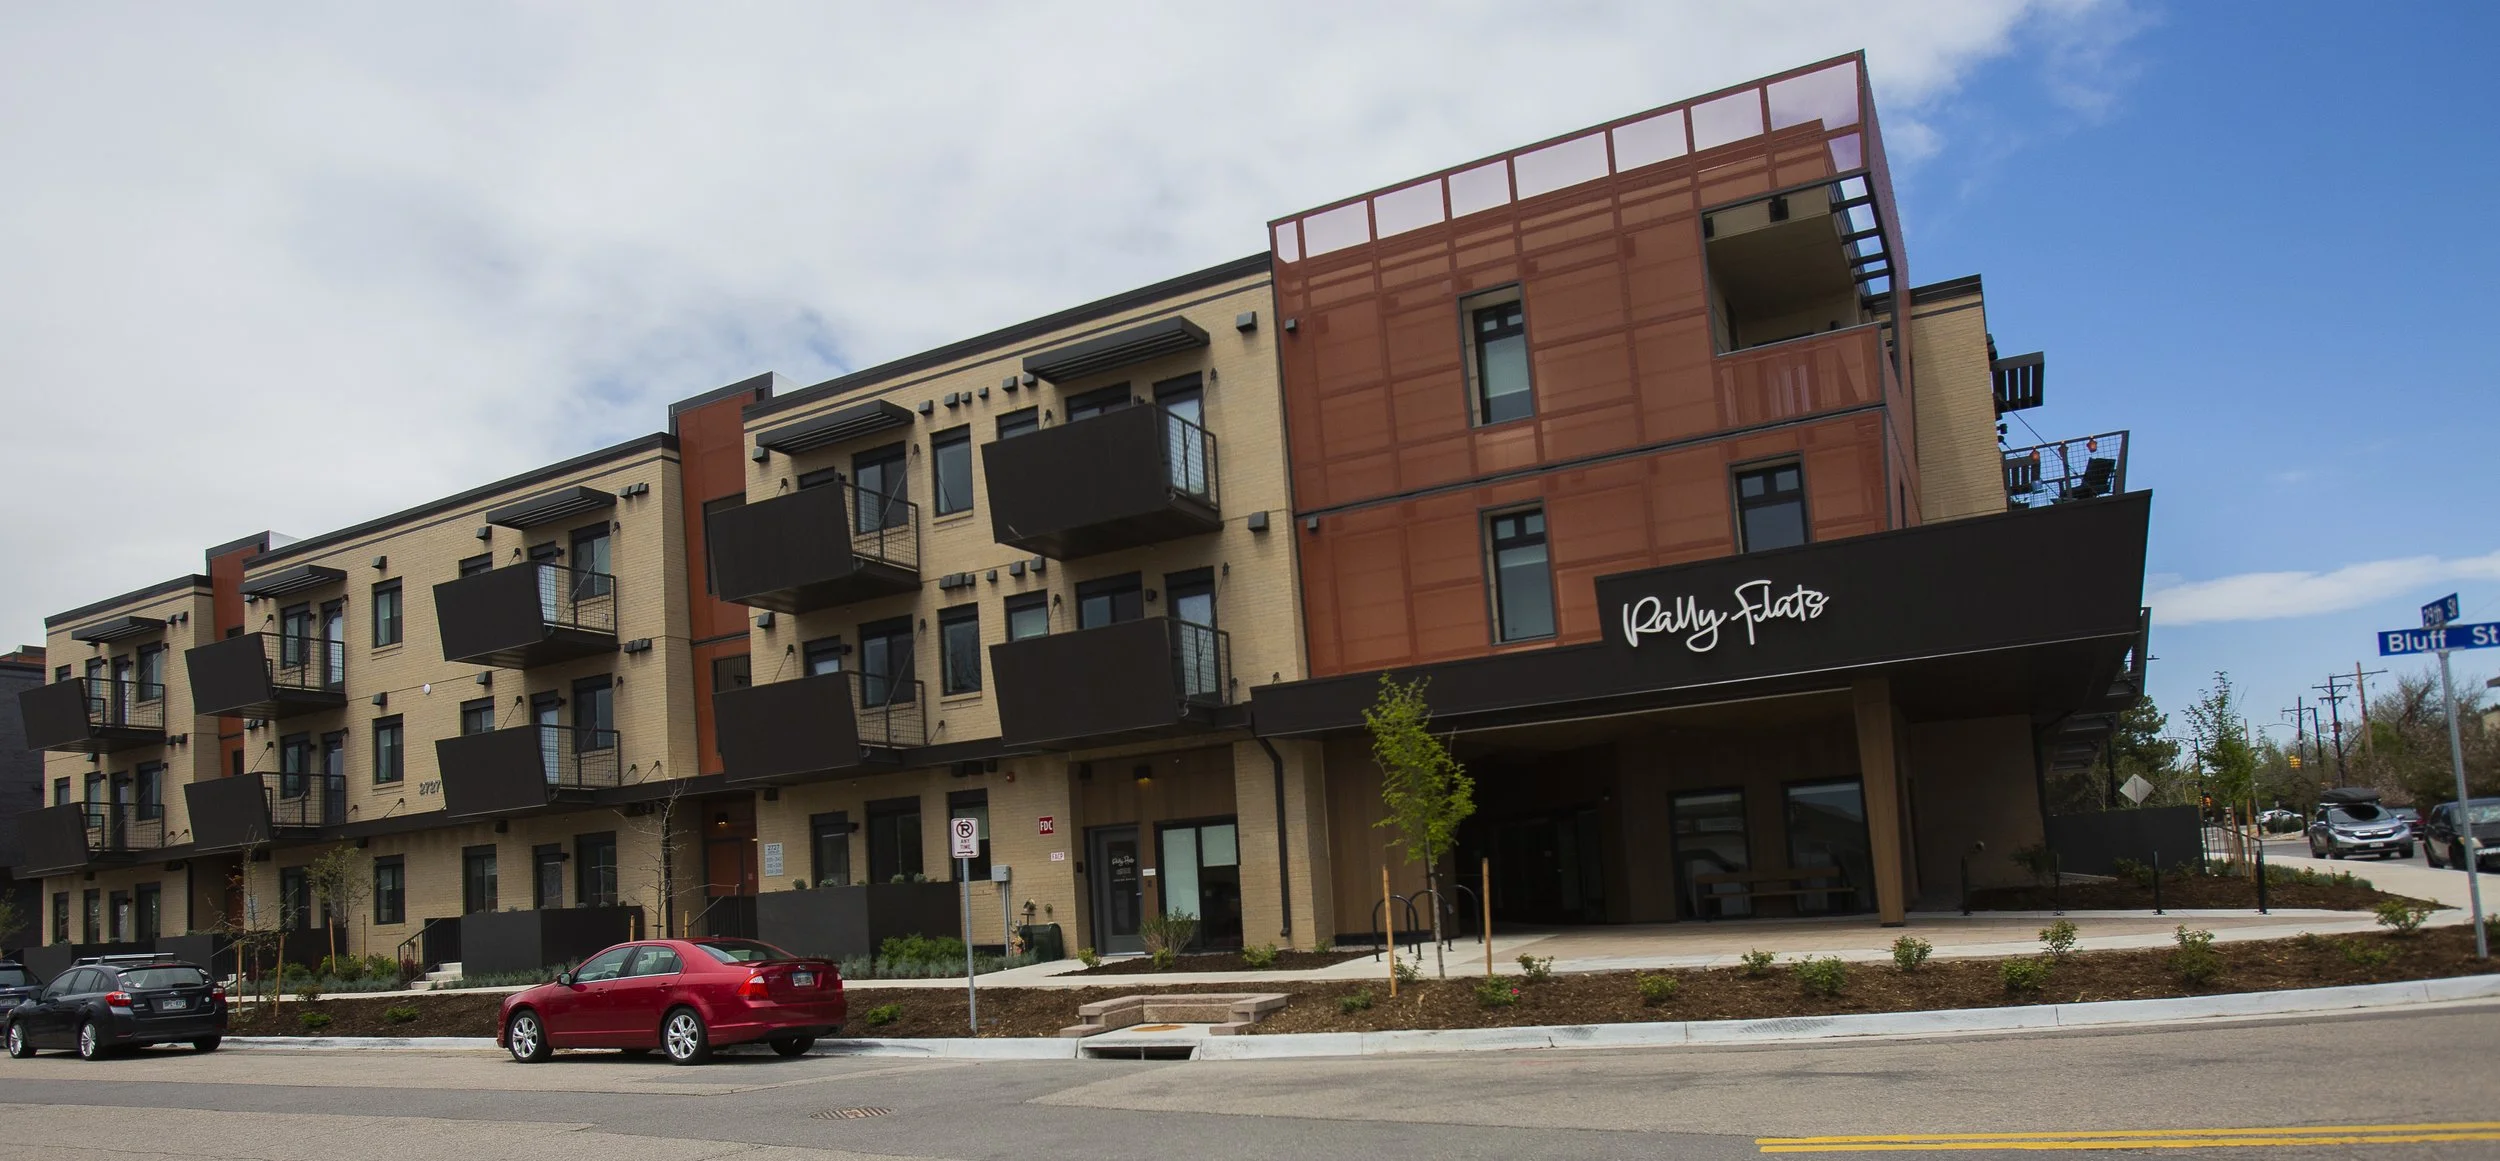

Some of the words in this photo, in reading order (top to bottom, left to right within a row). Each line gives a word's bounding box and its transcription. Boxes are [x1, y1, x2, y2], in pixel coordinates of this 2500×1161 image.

[1623, 596, 1728, 652] Rally
[1731, 580, 1829, 645] Flats
[2423, 604, 2443, 628] 29th
[2446, 597, 2457, 618] St
[2388, 629, 2446, 653] Bluff
[2472, 625, 2499, 646] St
[419, 780, 441, 795] 2727
[1040, 819, 1053, 832] FDC
